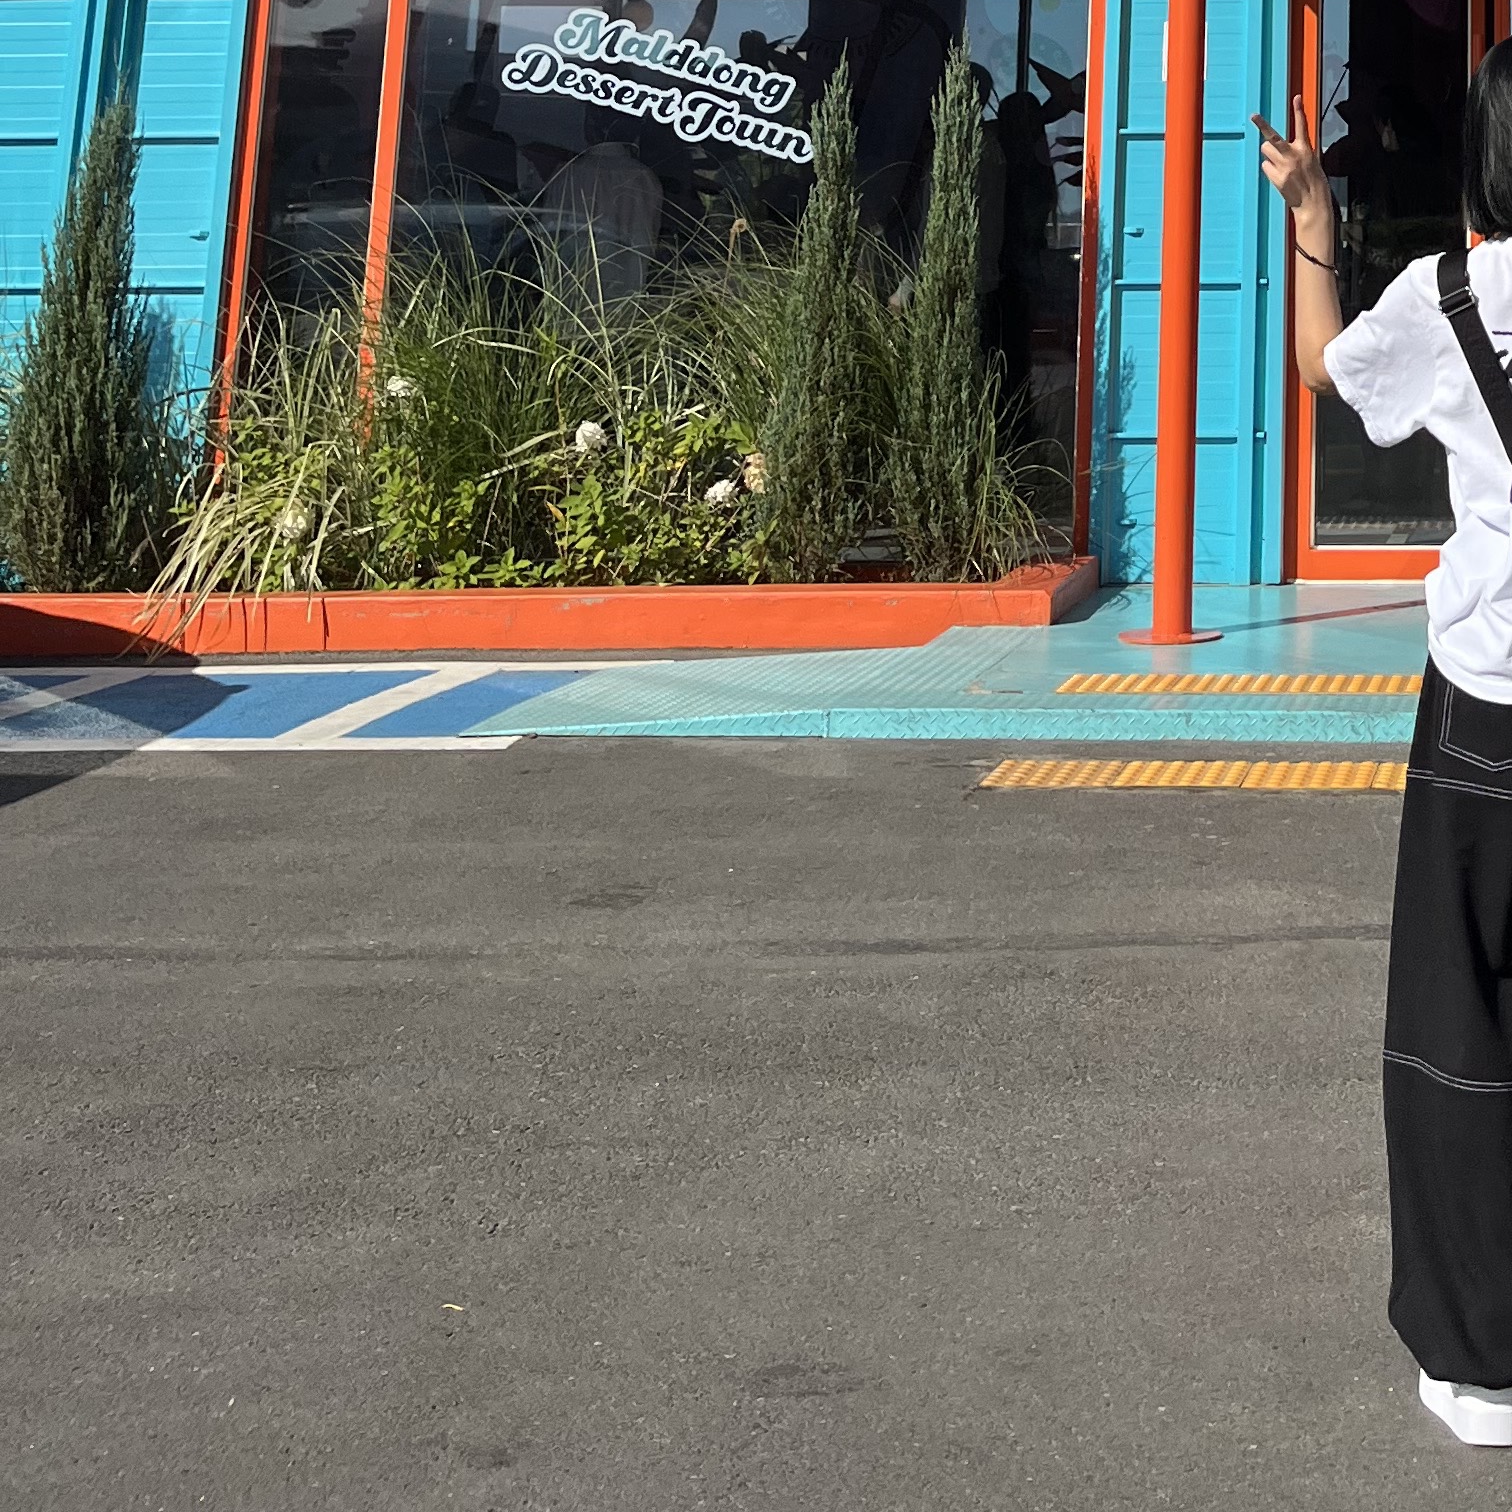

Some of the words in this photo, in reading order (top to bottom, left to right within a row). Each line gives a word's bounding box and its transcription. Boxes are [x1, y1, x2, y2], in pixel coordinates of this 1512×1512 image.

[502, 43, 683, 124] Dessert
[674, 90, 814, 163] Town
[554, 8, 797, 114] Malddong
